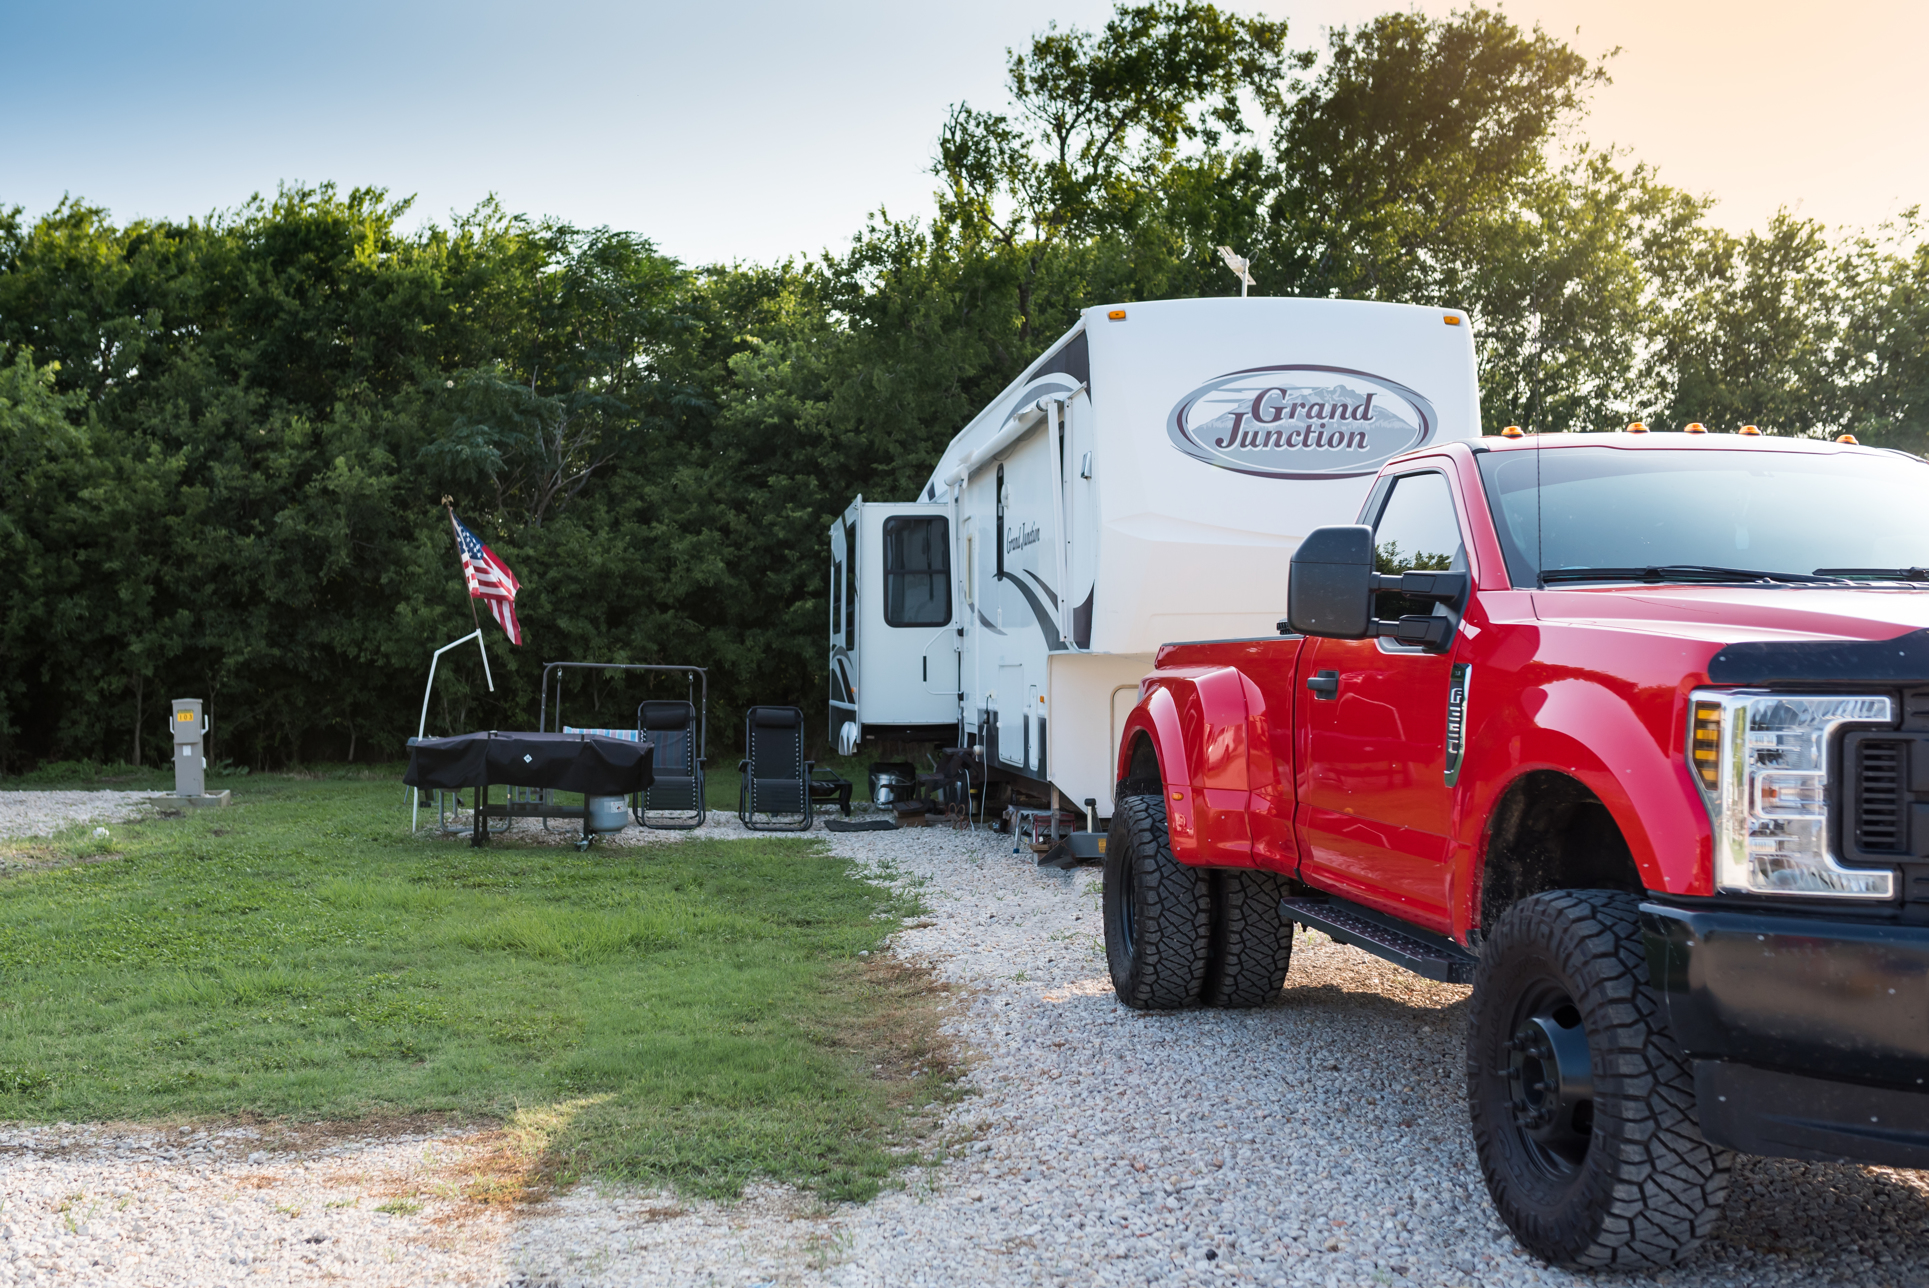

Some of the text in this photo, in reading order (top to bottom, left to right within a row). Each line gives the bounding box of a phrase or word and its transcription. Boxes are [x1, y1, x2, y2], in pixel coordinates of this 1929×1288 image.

[1251, 387, 1377, 424] Grand
[1214, 412, 1370, 450] Junction
[1006, 520, 1040, 554] Grand Junction
